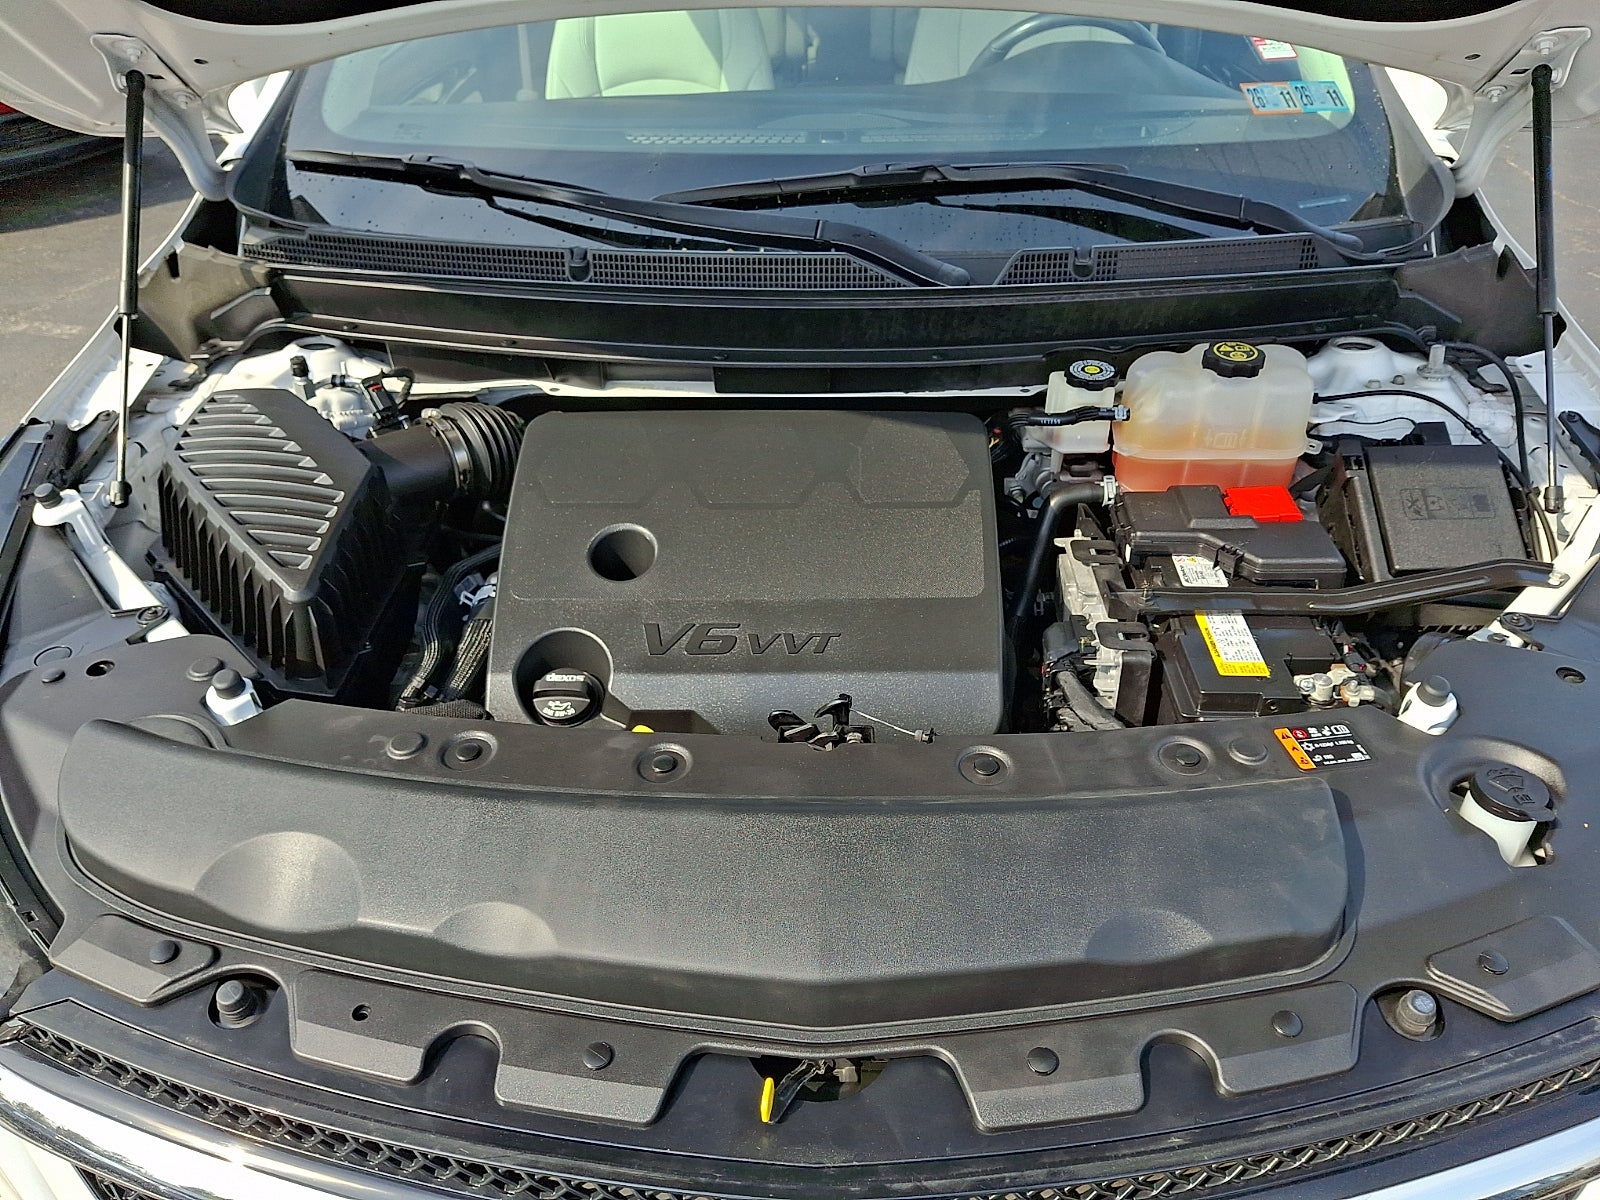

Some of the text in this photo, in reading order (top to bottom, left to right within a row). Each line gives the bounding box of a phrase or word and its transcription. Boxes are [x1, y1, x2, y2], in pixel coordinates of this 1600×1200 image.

[1246, 88, 1266, 109] 26
[1279, 90, 1298, 109] 11
[1295, 86, 1314, 107] 26
[1326, 89, 1344, 107] 11
[643, 622, 842, 656] V6 VVT
[545, 672, 586, 682] dexos
